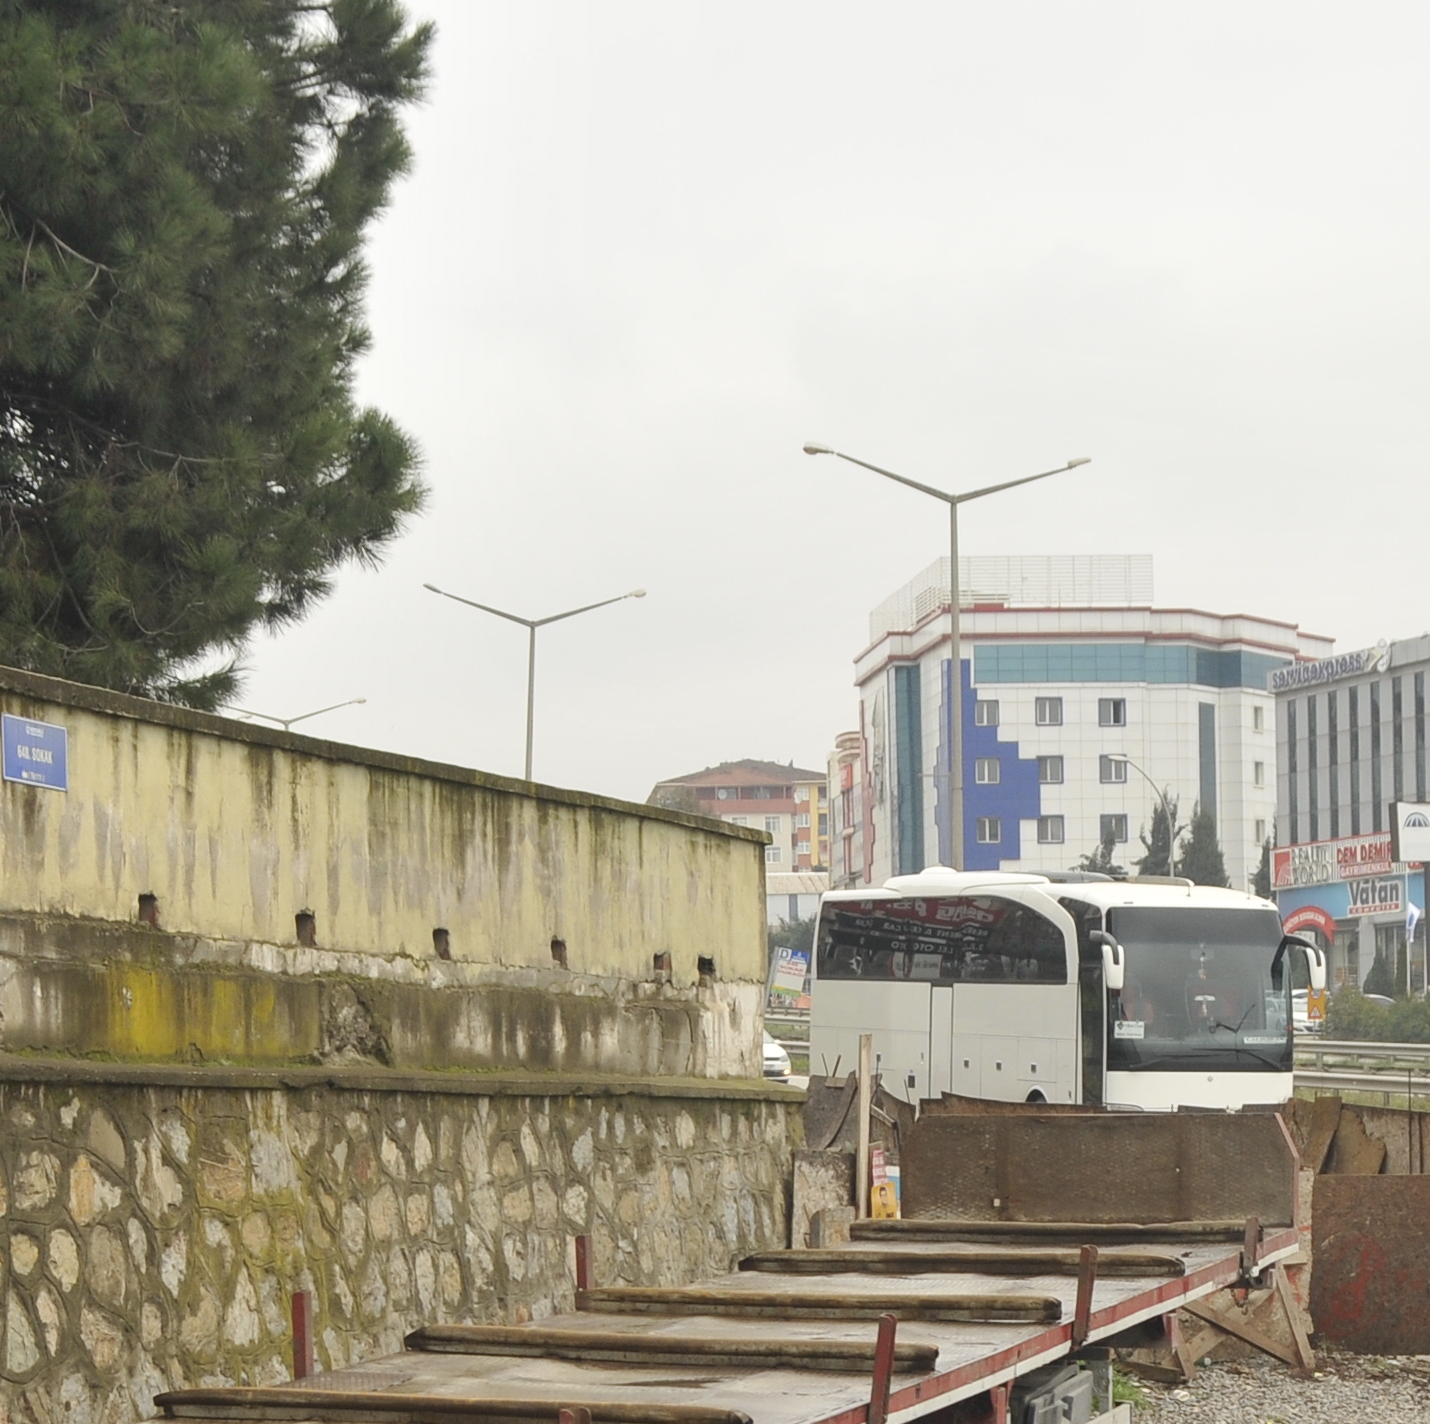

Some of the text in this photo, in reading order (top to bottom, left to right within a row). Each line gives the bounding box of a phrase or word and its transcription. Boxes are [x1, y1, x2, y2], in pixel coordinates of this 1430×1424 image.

[1272, 653, 1365, 690] servicexpress
[1349, 878, 1400, 906] Vatan
[1351, 903, 1396, 914] COMPUTER
